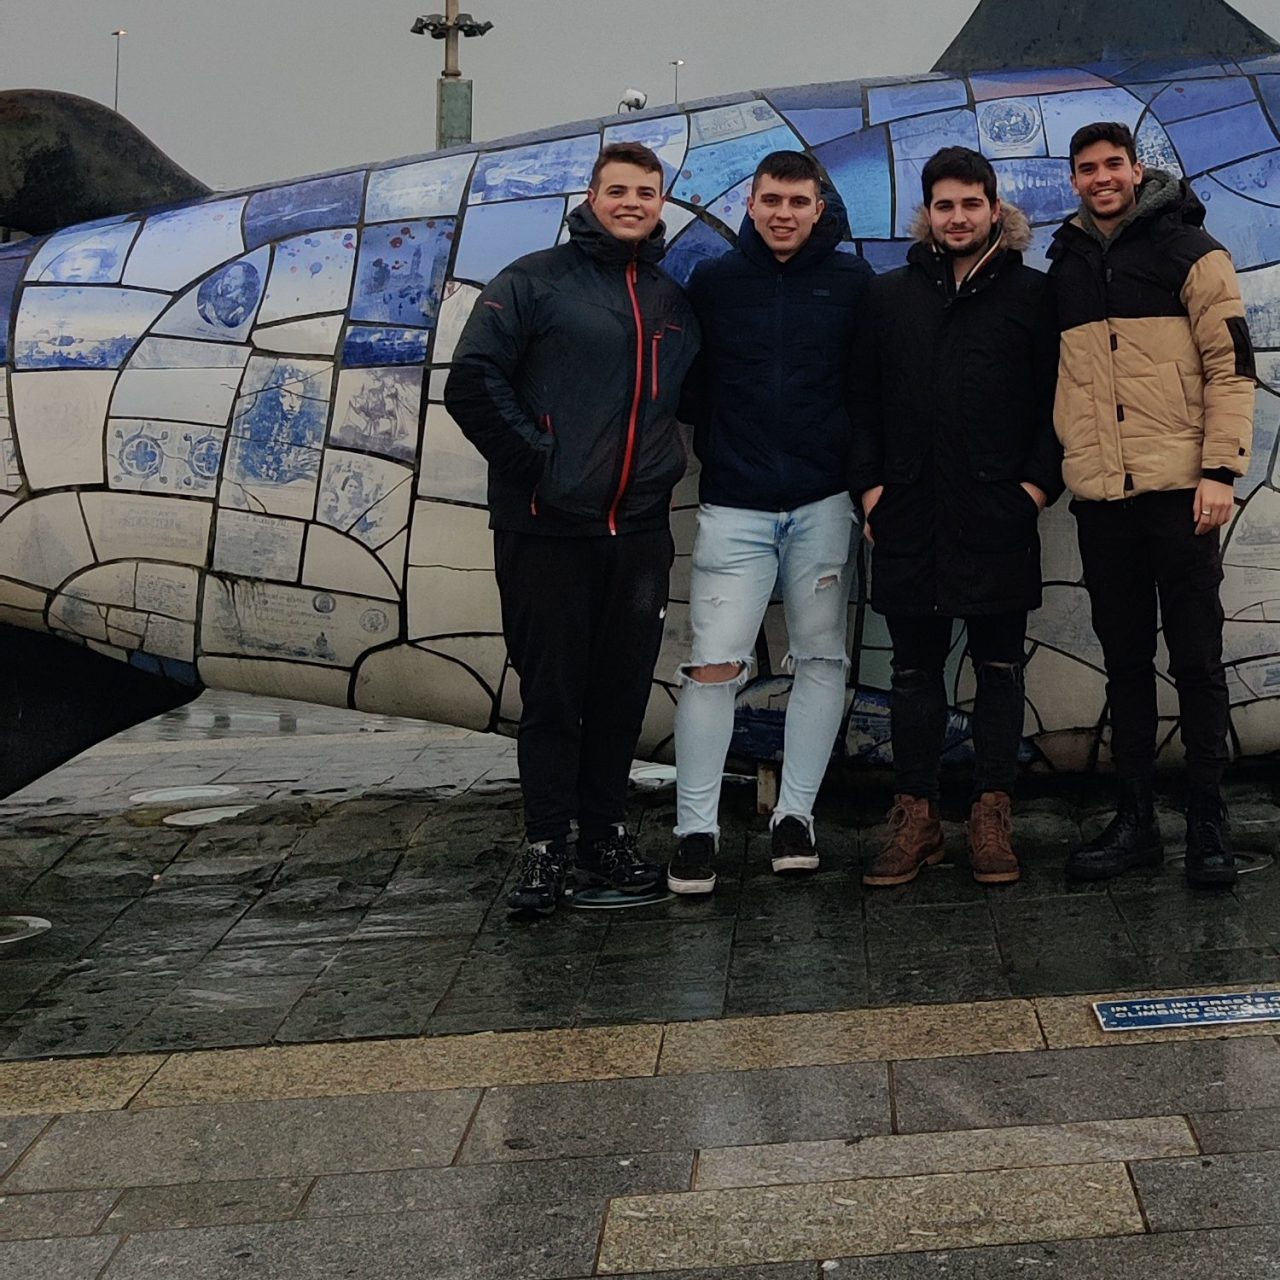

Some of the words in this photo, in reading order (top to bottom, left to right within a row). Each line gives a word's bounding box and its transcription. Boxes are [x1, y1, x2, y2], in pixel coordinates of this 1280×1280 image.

[1115, 1007, 1200, 1018] CLIMBING
[1203, 1003, 1253, 1012] ONTO
[1132, 1003, 1167, 1011] THE
[1171, 997, 1266, 1008] INTERESTS
